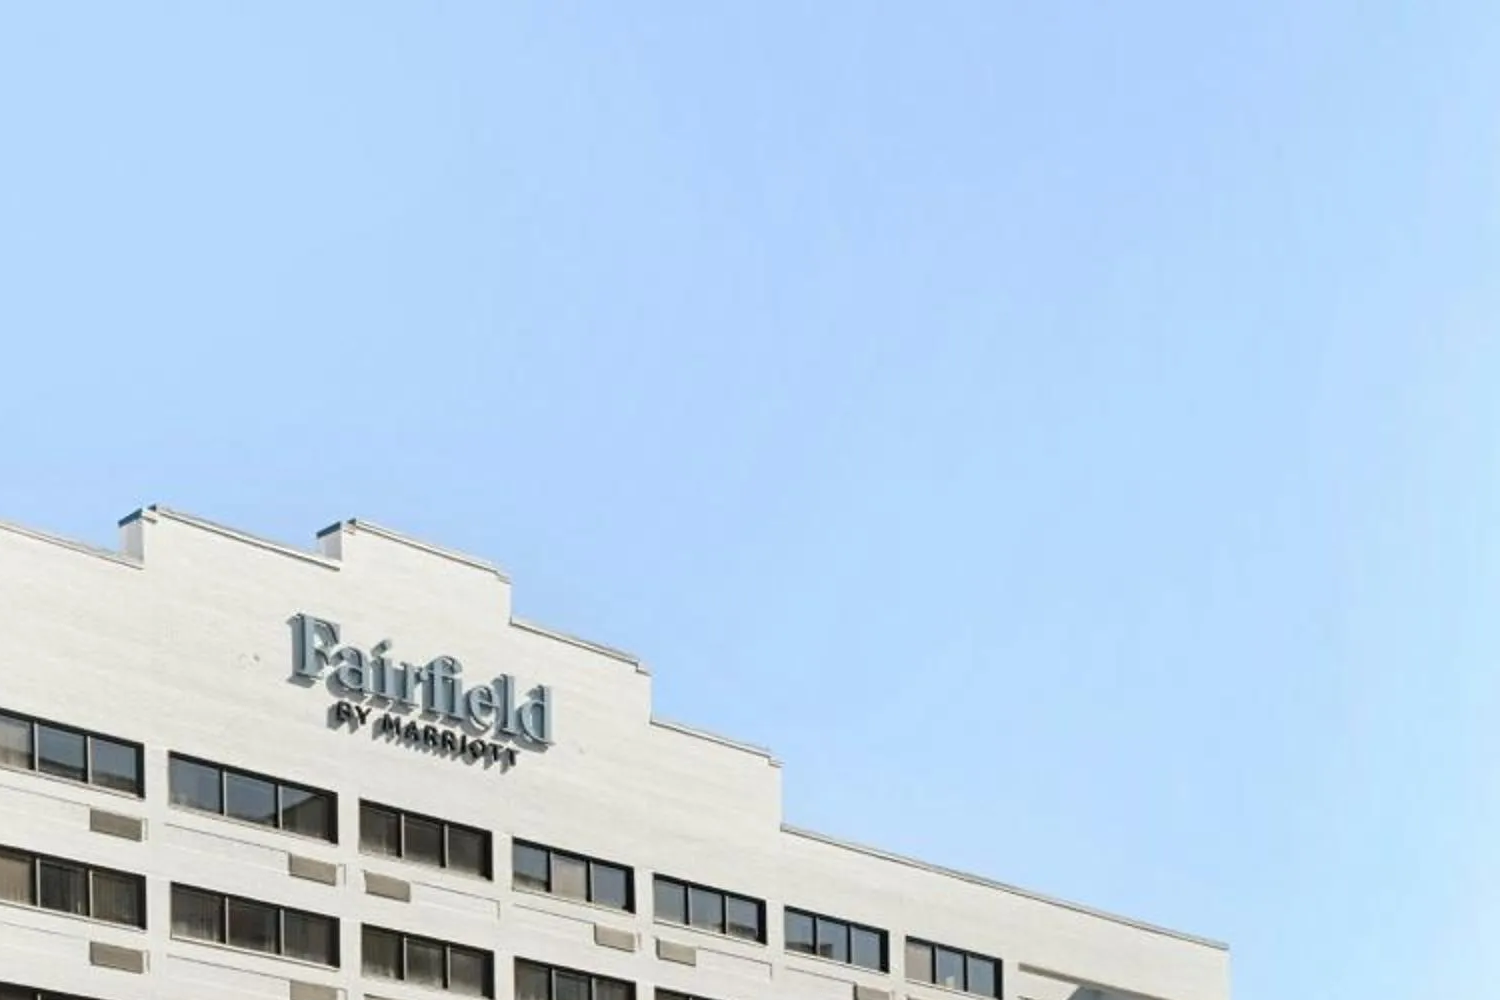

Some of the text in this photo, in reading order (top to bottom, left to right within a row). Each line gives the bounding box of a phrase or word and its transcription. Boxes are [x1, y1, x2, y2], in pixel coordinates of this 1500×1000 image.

[287, 612, 554, 748] Fairfield
[334, 700, 520, 768] BY MARRIOTT
